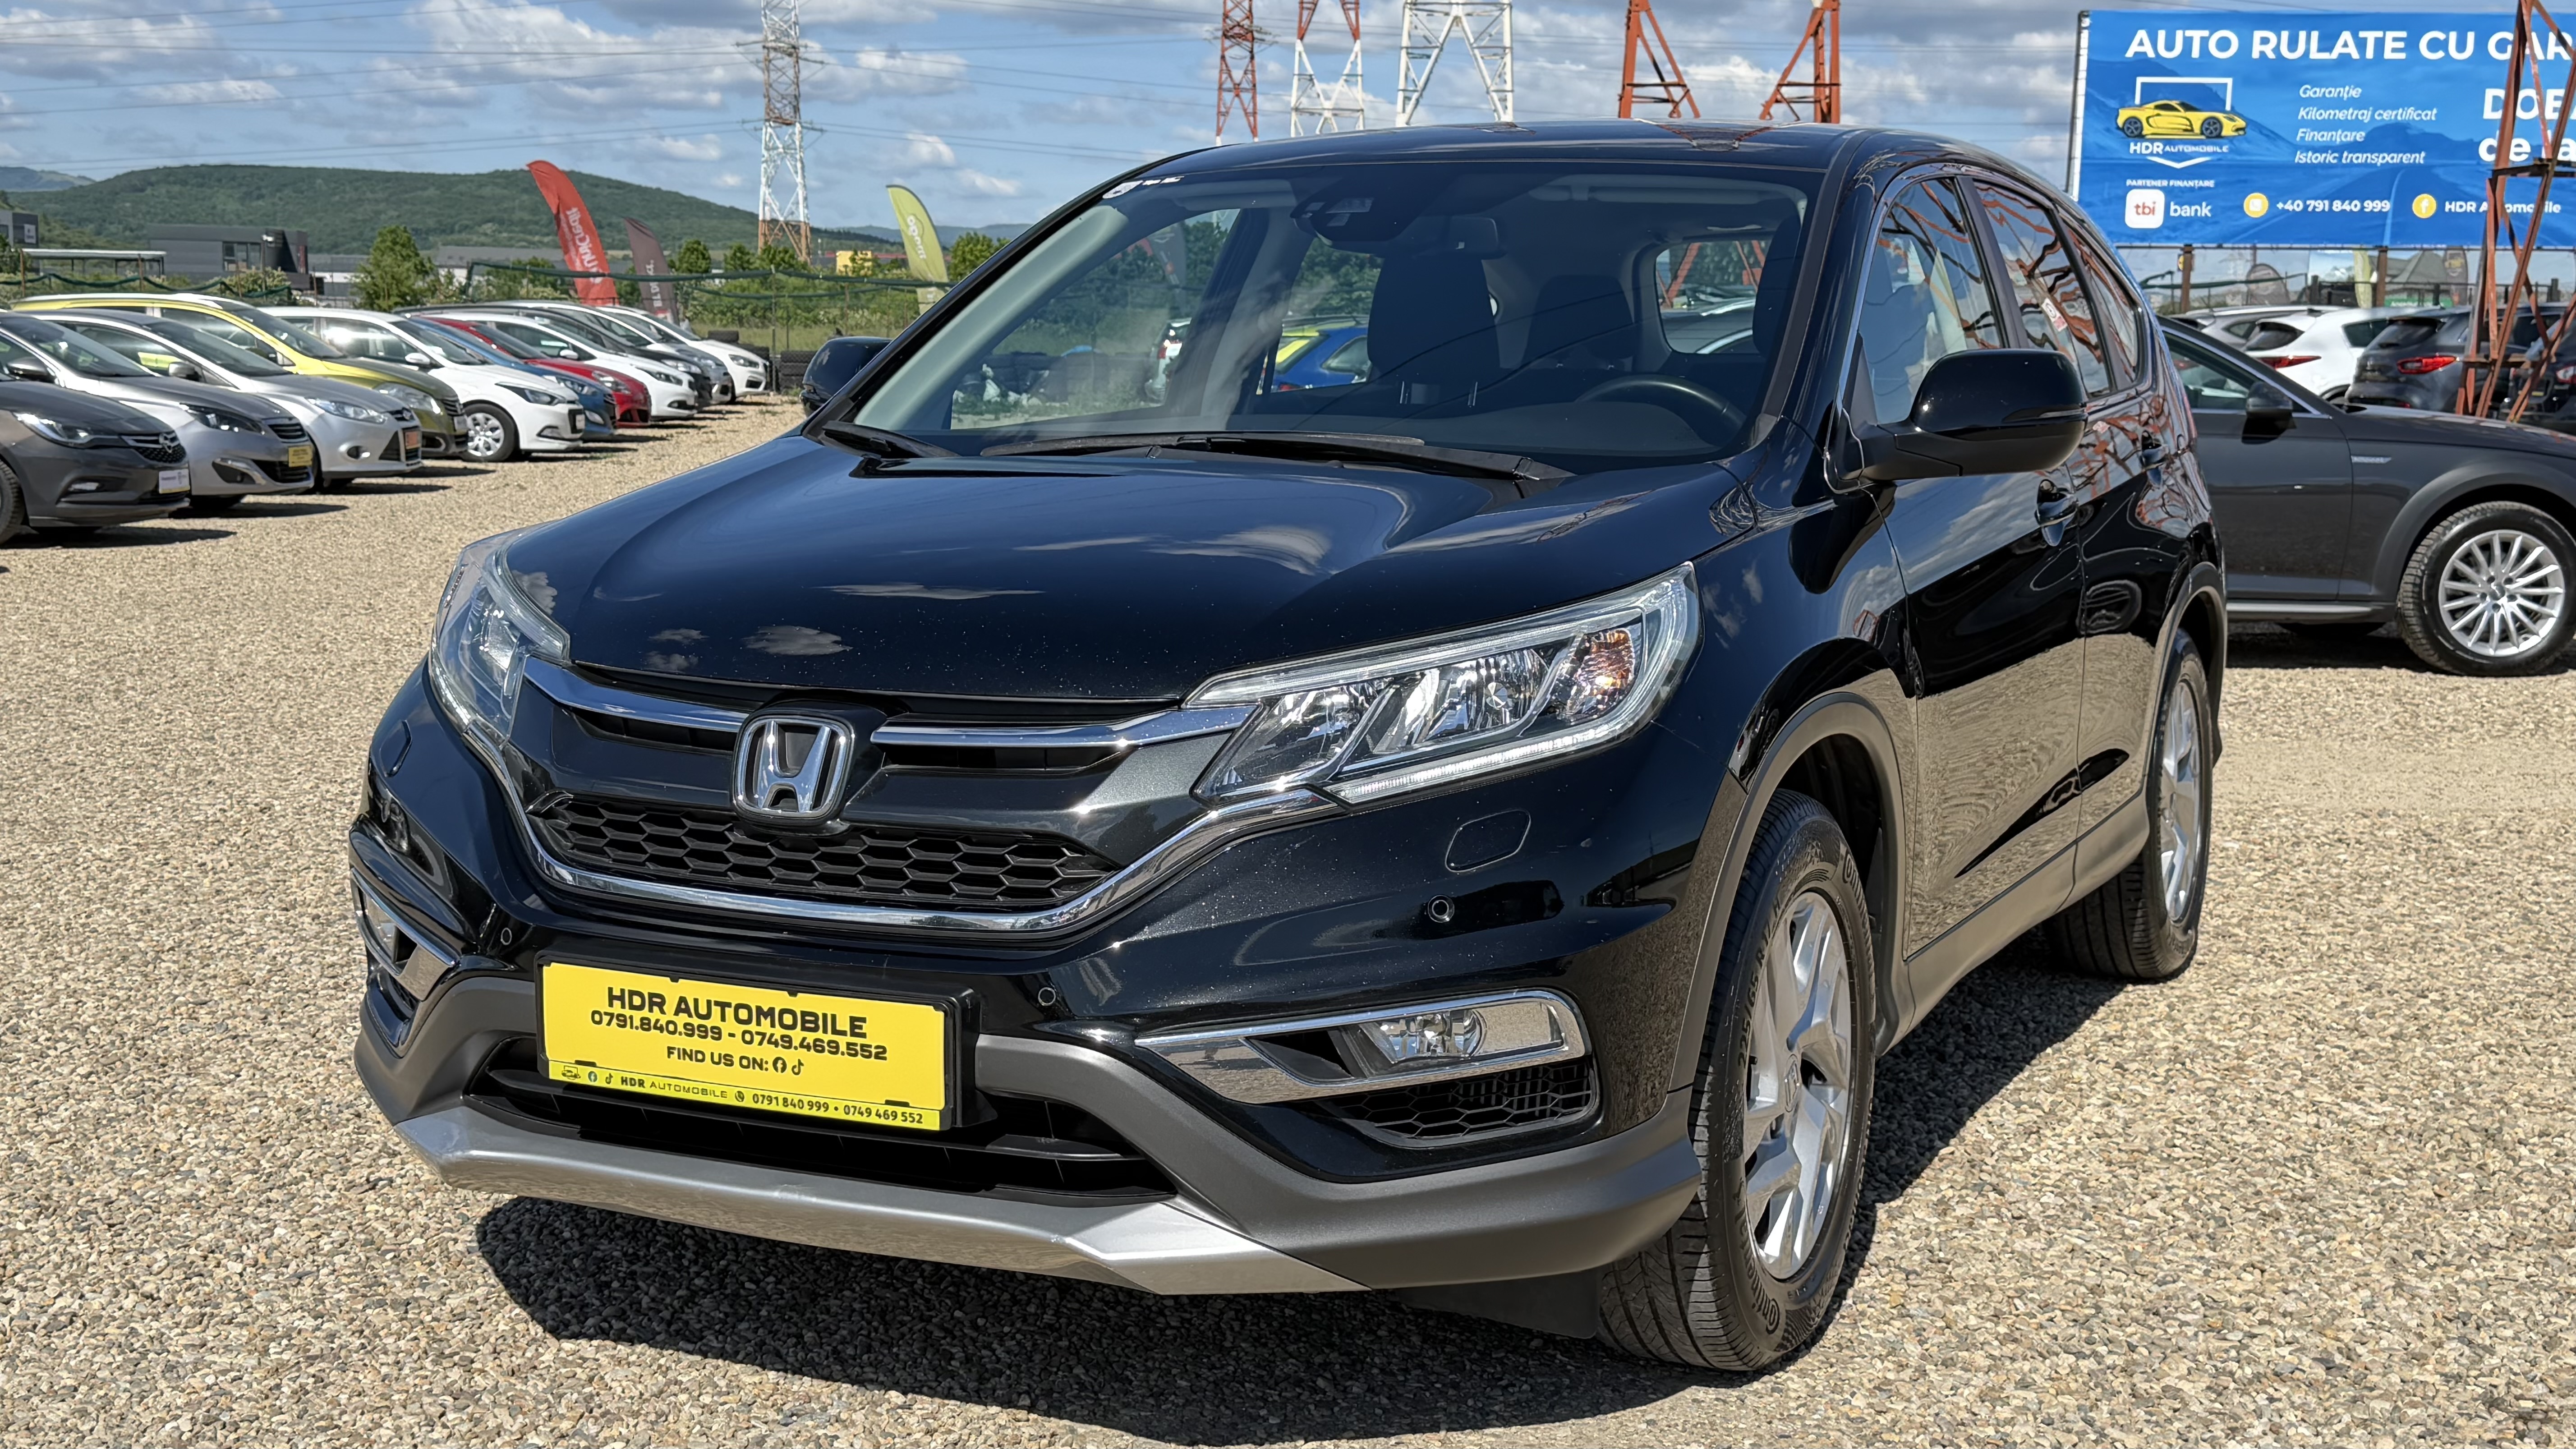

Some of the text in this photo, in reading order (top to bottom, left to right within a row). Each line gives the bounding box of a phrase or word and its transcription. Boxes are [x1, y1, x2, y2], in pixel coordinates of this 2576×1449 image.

[2125, 29, 2239, 59] AUTO
[2251, 30, 2407, 60] RULATE
[2418, 31, 2475, 60] CU
[2299, 84, 2362, 101] Garanție
[2297, 106, 2438, 123] Kilometraj certificat
[2296, 128, 2366, 144] Finanțare
[2129, 142, 2229, 154] HDR AUTOMOBILE
[2478, 129, 2531, 162] de
[2295, 150, 2426, 167] Istoric transparent
[2126, 179, 2215, 189] PARTENER FINANȚARE
[2134, 200, 2212, 217] tbi bank
[2276, 199, 2391, 212] +40 791 840 999
[2444, 201, 2562, 213] HDR Aomoile
[607, 986, 867, 1039] HDR AUTOMOBILE
[591, 1009, 722, 1041] 0791.840.999
[741, 1029, 888, 1061] 0749.469.552
[667, 1046, 769, 1072] FIND US ON:
[621, 1076, 924, 1124] HDR AUTOMOBILE 0791 840 999 0749 469 552
